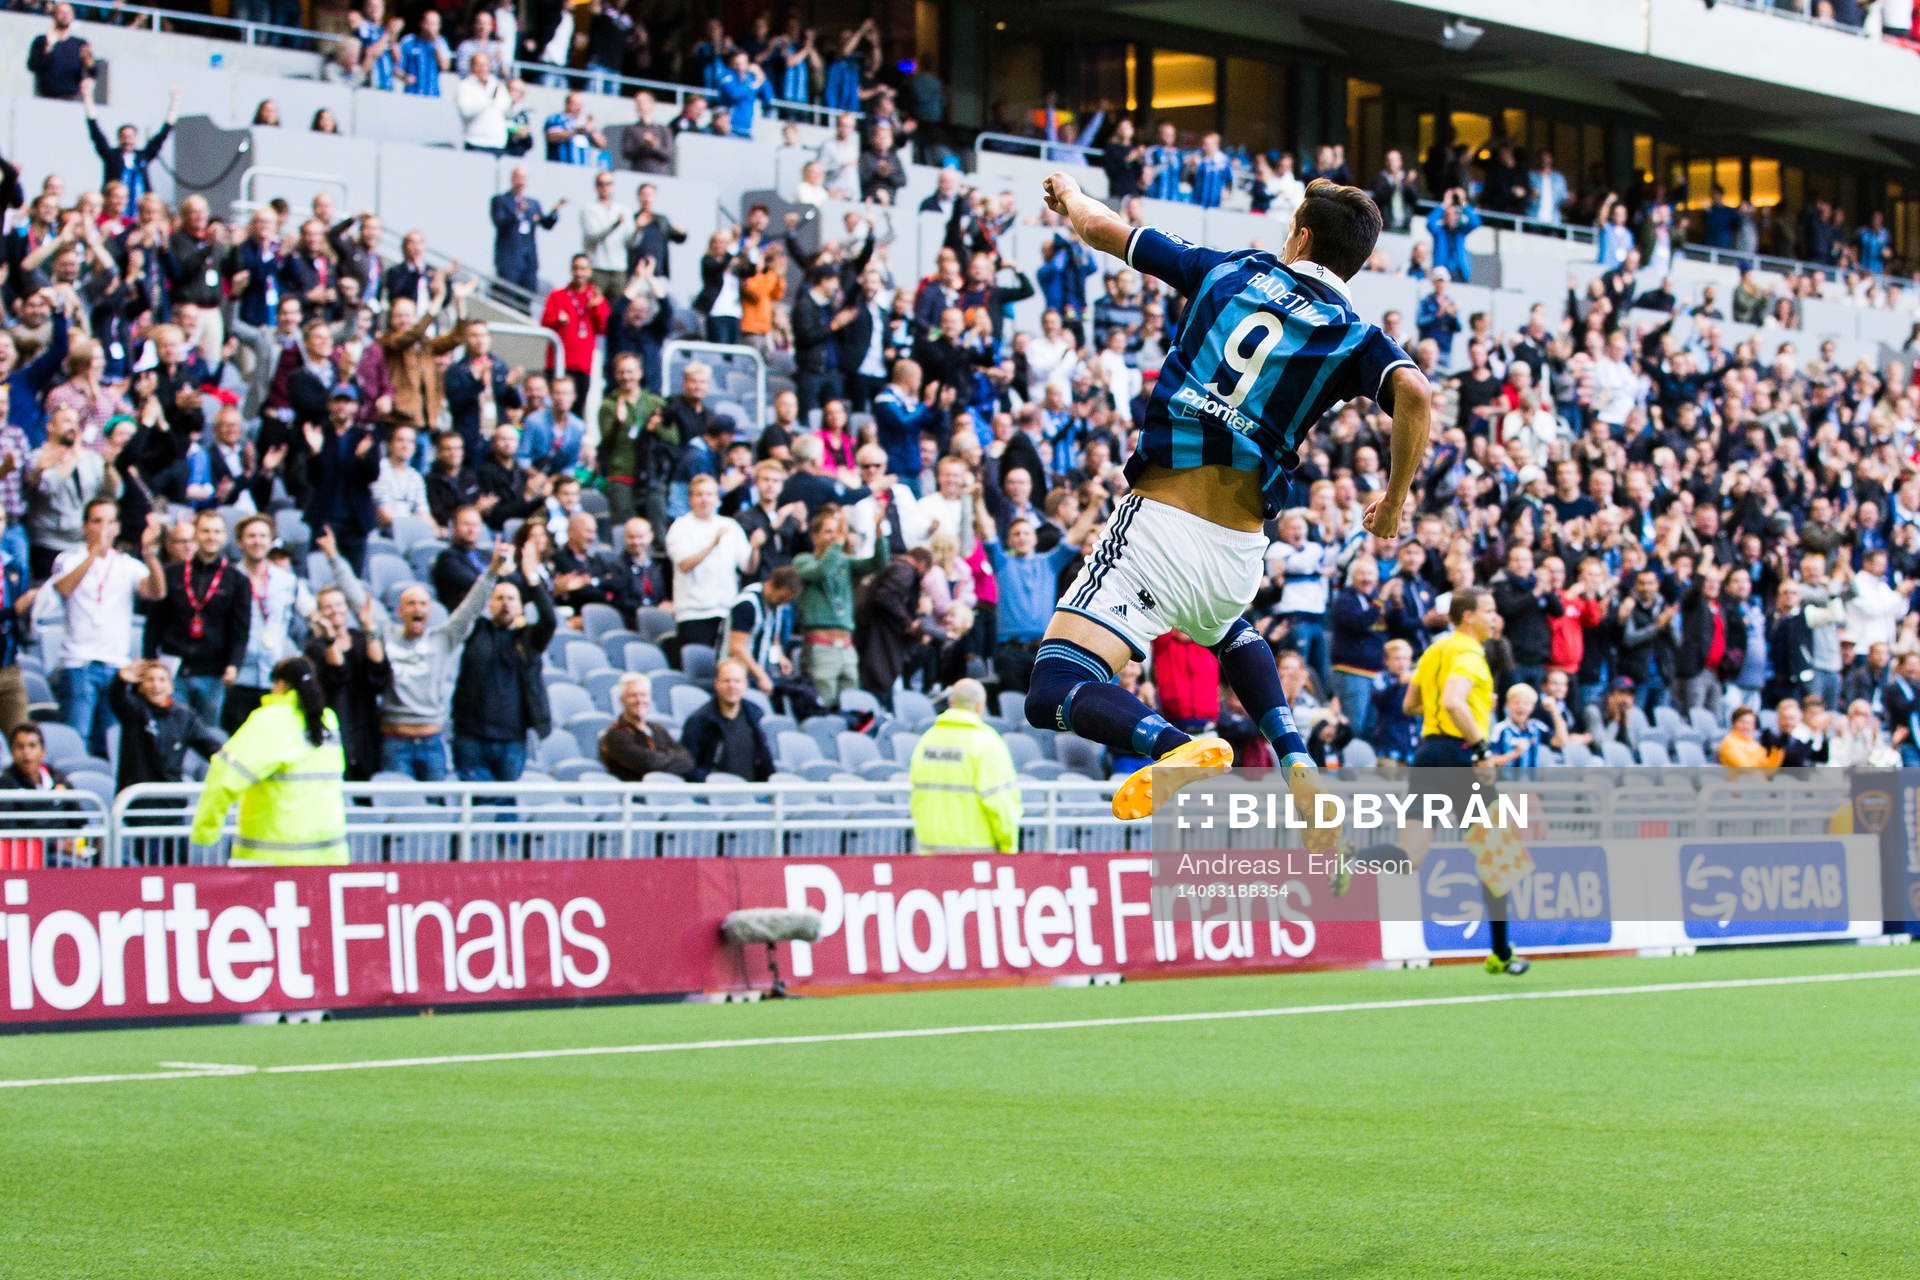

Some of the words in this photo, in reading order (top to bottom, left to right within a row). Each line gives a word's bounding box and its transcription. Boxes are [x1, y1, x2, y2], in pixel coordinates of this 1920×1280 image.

[1204, 311, 1284, 409] 9
[1178, 386, 1255, 436] Prioritet
[784, 861, 1103, 977] Prioritet
[1108, 858, 1316, 965] Finans
[1507, 870, 1604, 920] VEAB
[1740, 863, 1843, 912] SVEAB
[329, 871, 610, 997] Finans
